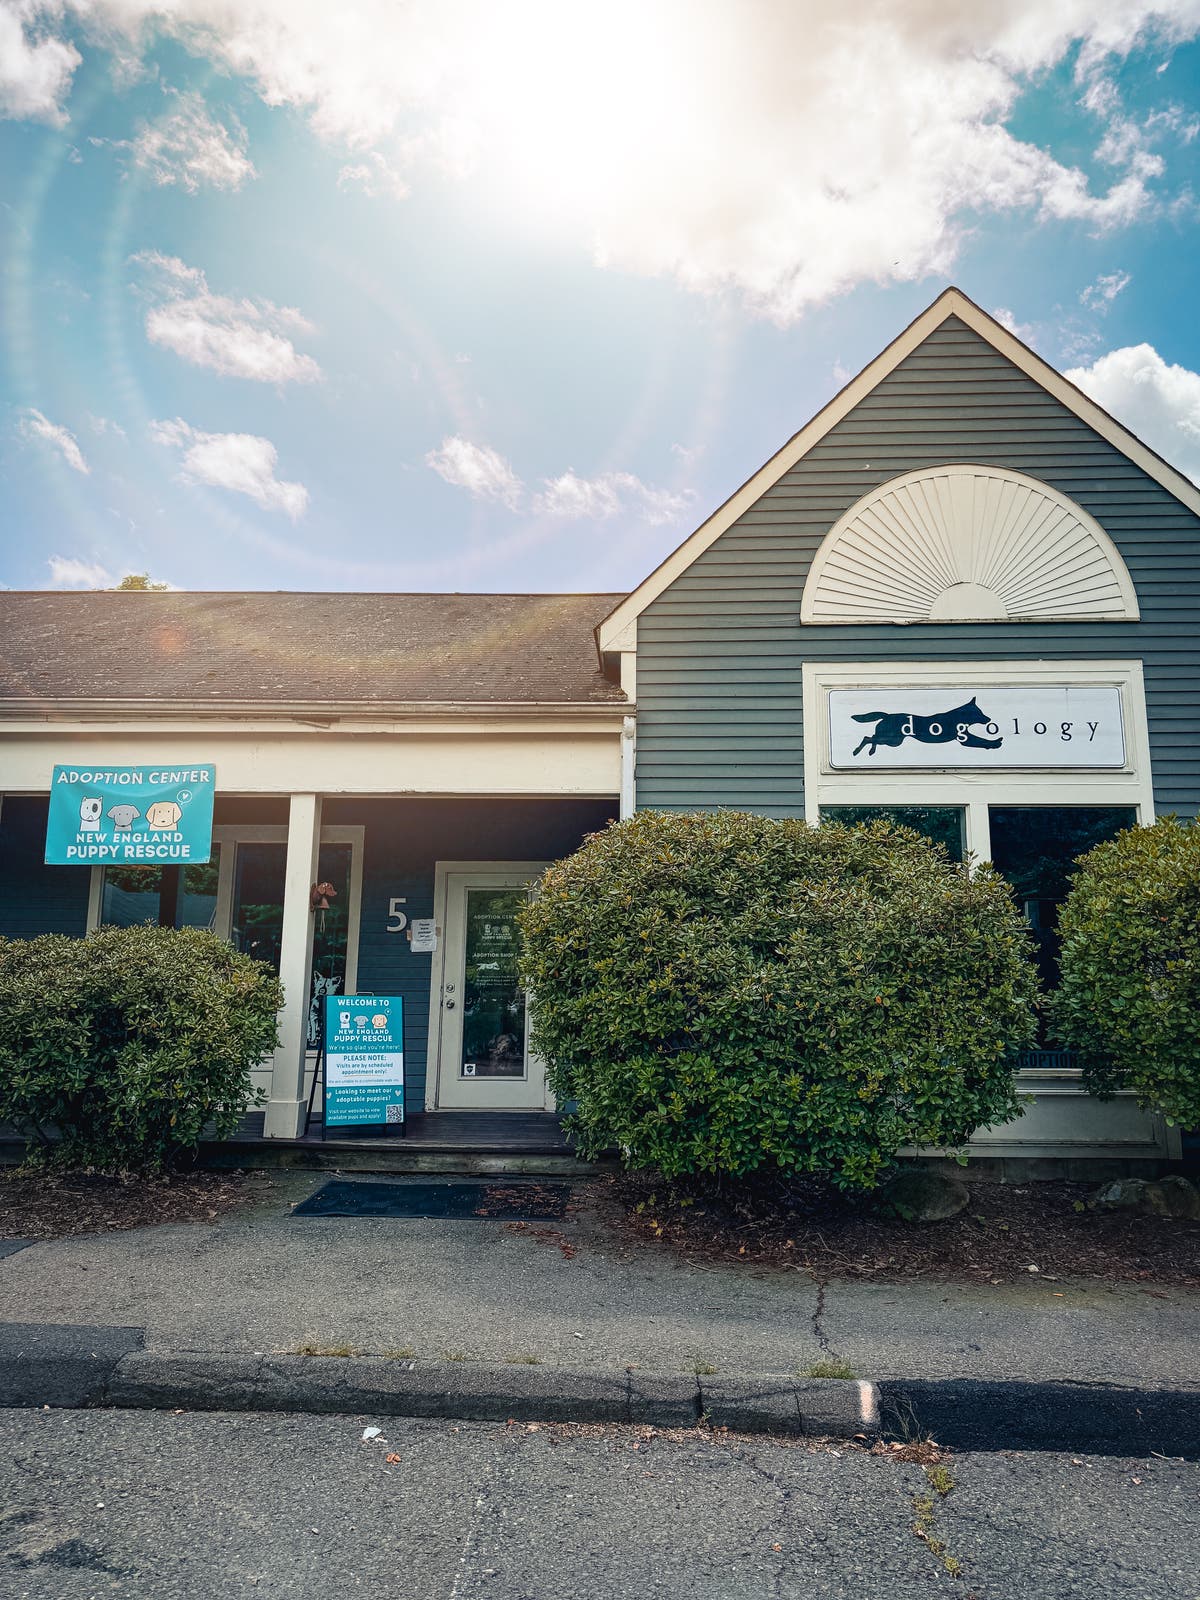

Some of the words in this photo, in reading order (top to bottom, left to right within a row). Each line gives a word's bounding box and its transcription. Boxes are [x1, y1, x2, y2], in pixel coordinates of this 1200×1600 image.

[900, 715, 1100, 742] dogology
[57, 771, 143, 785] ADOPTION
[148, 770, 210, 784] CENTER
[76, 833, 107, 843] NEW
[112, 832, 183, 843] ENGLAND
[66, 845, 121, 858] PUPPY
[124, 844, 191, 858] RESCUE
[386, 897, 407, 932] 5
[379, 999, 390, 1007] TO
[366, 1095, 391, 1103] puppies?
